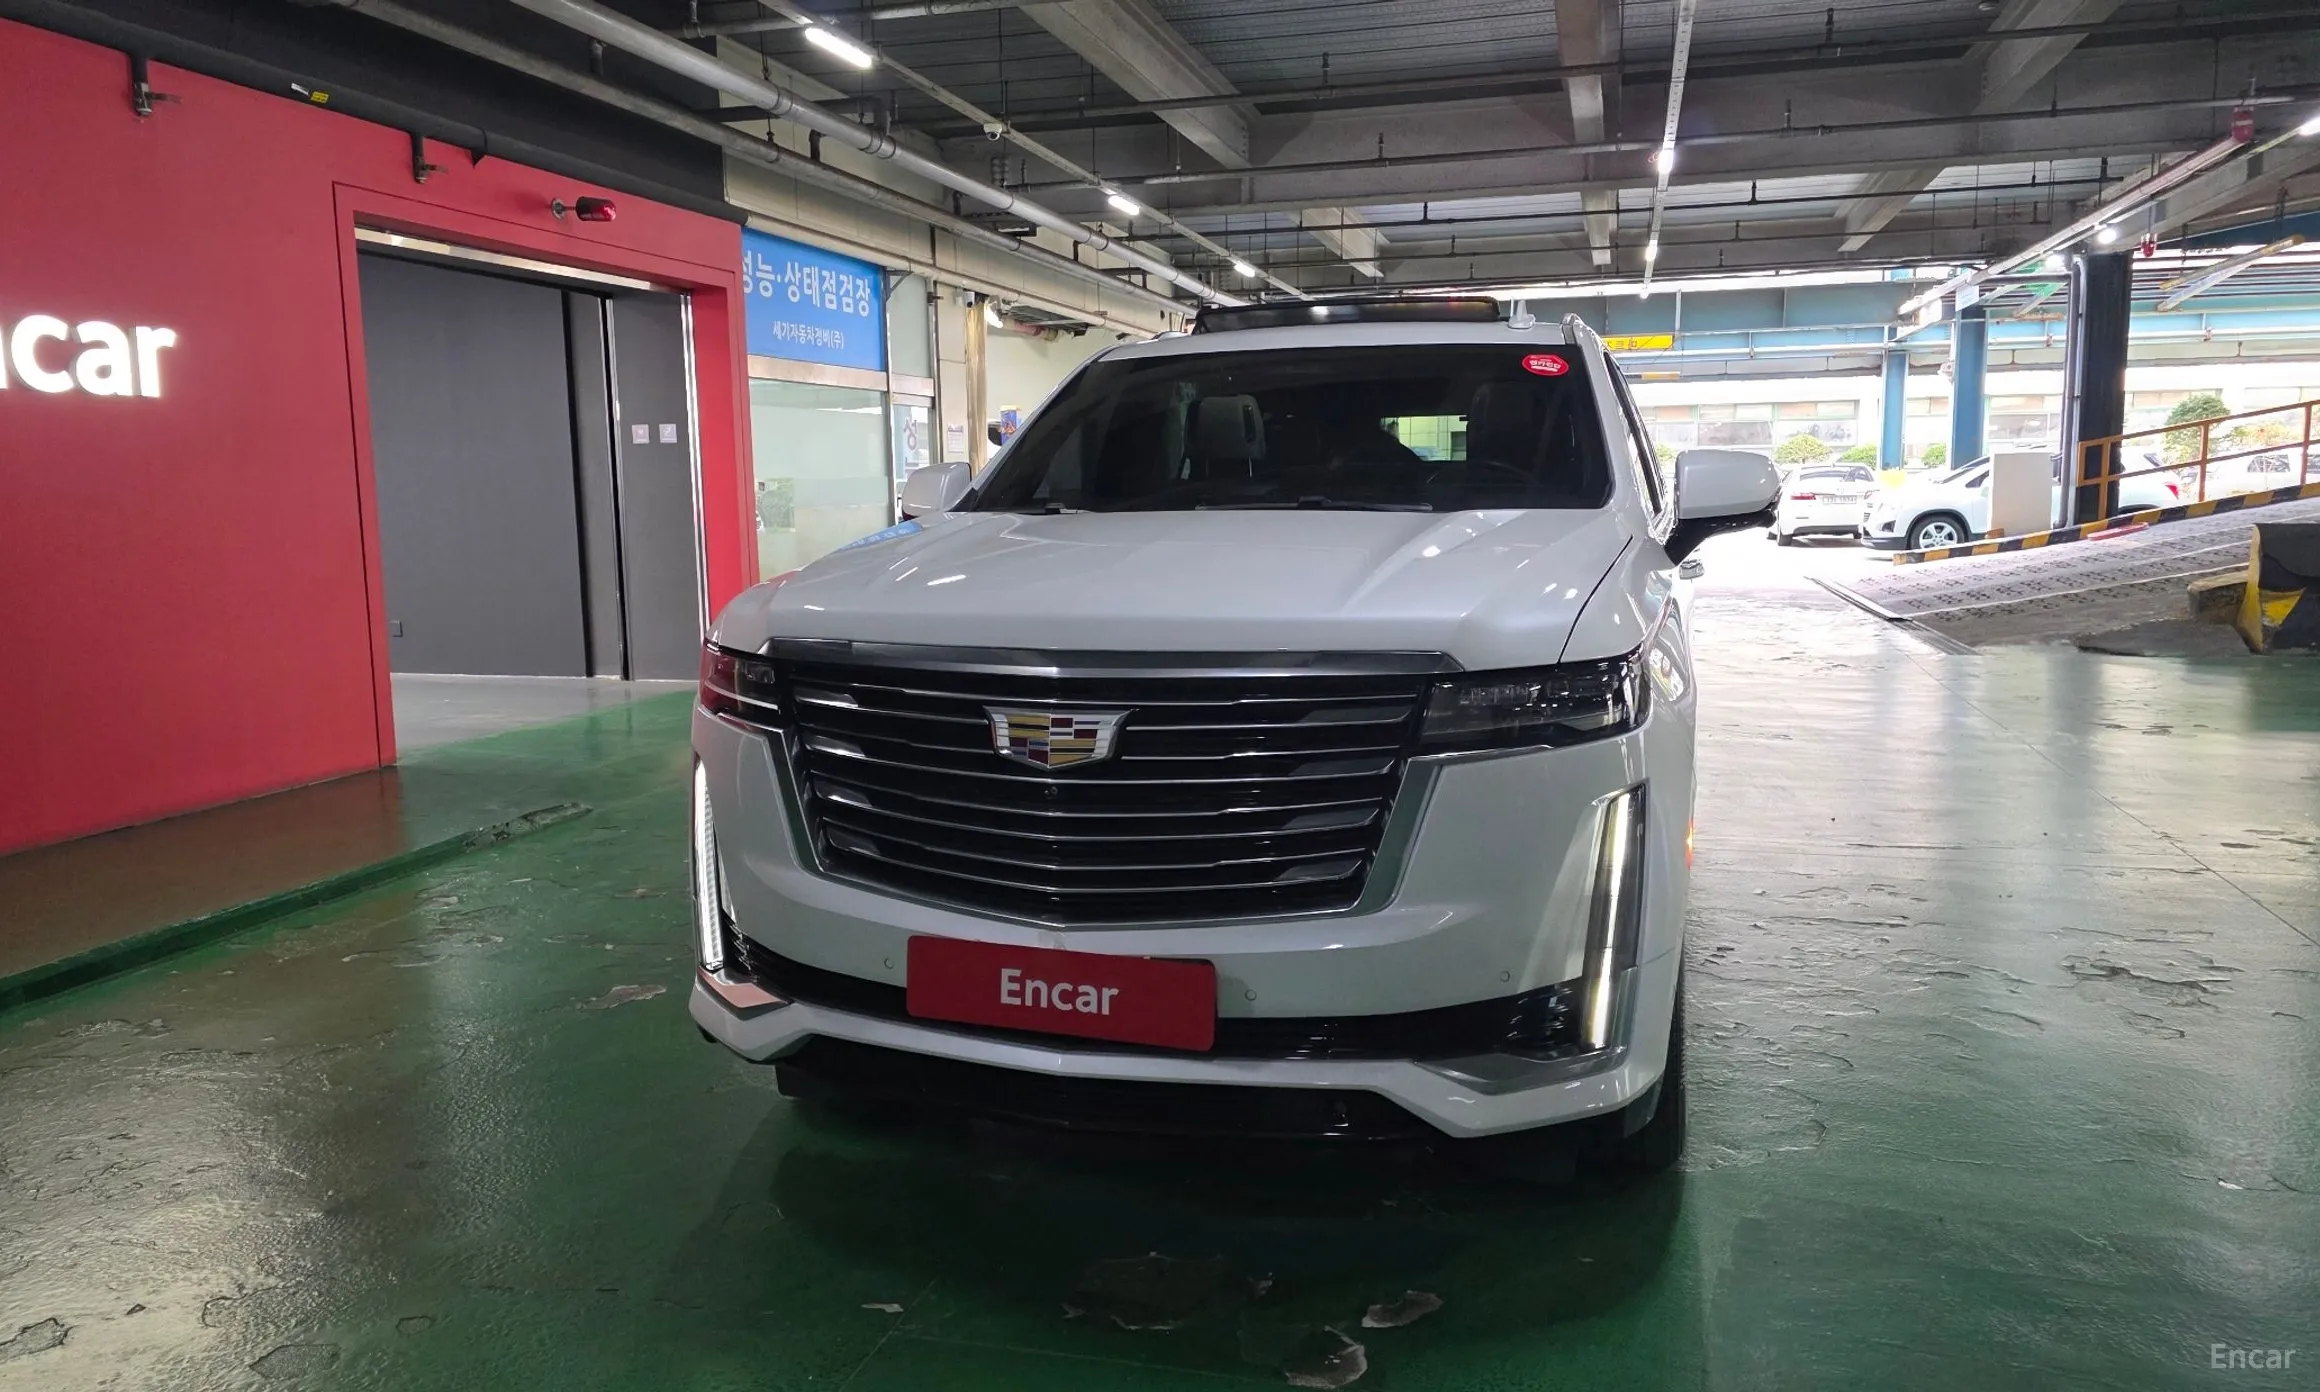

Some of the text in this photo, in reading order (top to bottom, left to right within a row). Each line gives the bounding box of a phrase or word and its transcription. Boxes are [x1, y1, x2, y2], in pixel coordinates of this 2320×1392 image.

[0, 314, 178, 398] car
[773, 319, 844, 349] 세기자동차정비(주)
[1000, 967, 1120, 1016] Encar
